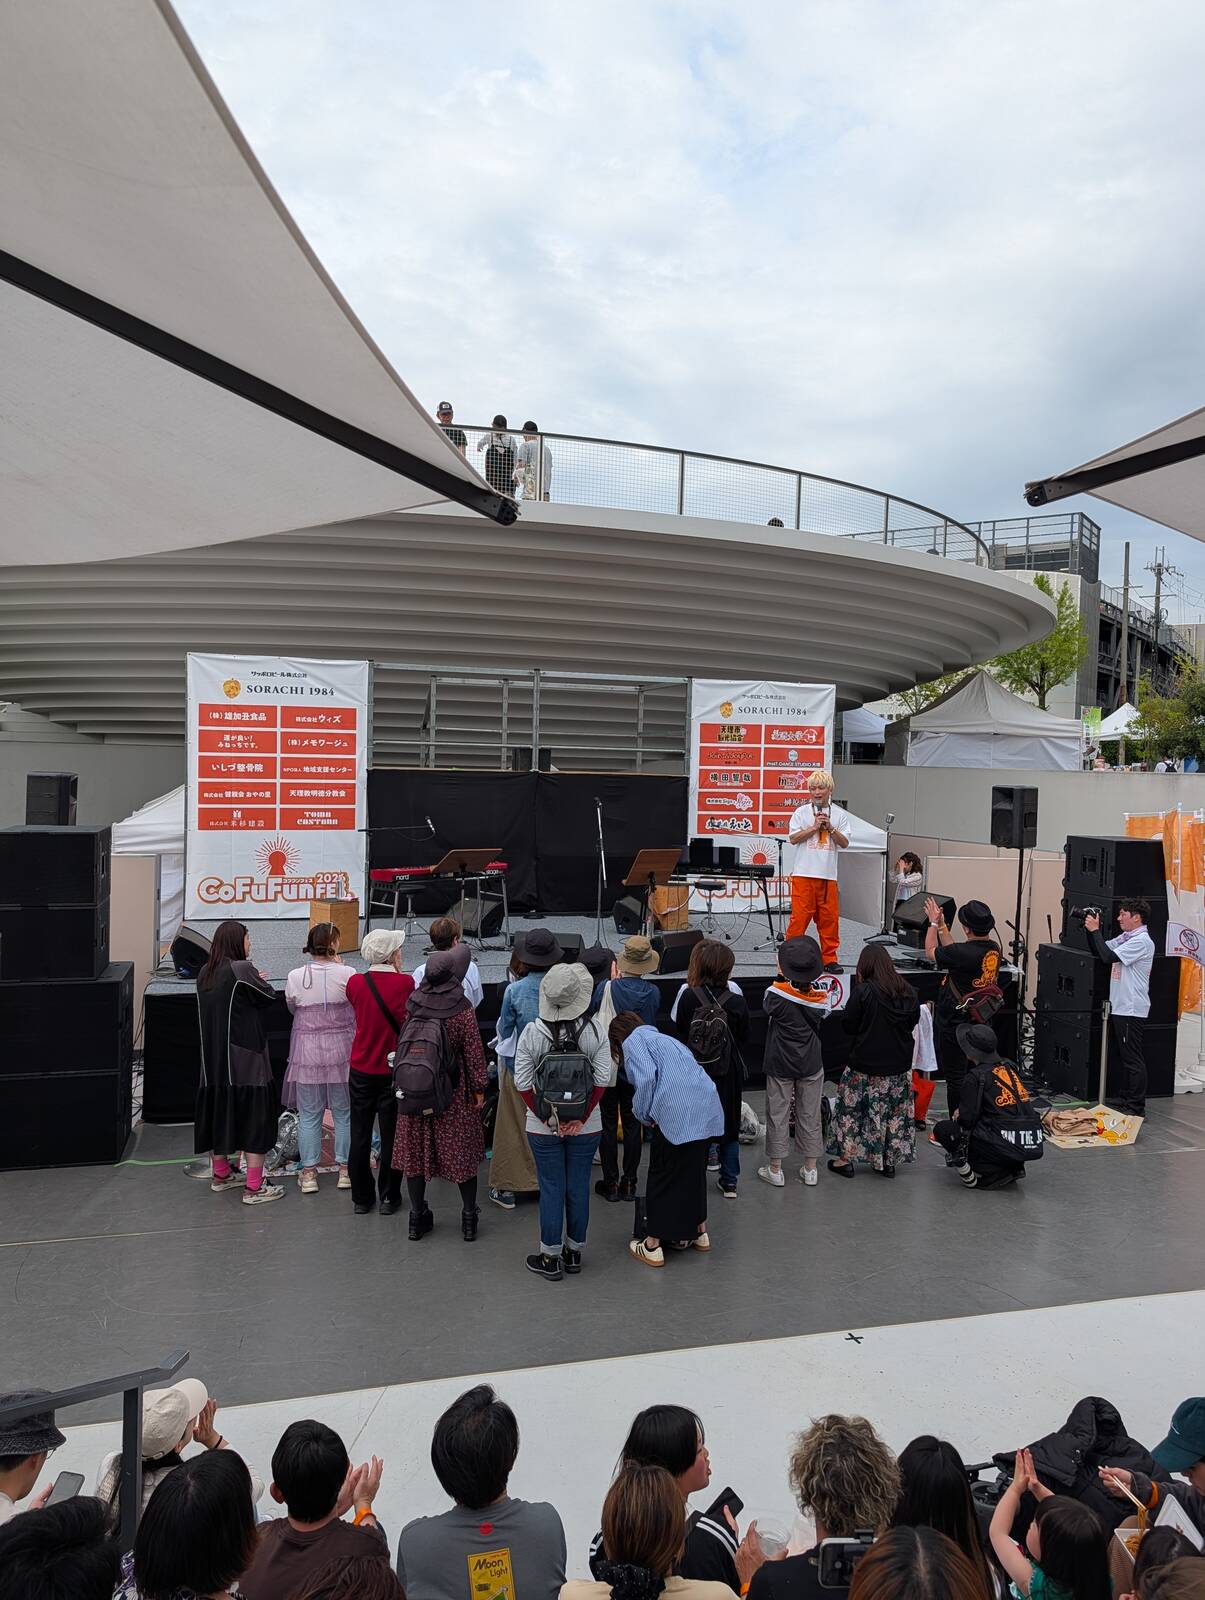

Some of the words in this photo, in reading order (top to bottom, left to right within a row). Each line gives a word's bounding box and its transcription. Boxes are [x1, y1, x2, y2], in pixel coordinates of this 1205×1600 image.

[246, 685, 304, 695] SORACHI
[309, 687, 335, 696] 1984
[738, 706, 783, 715] SORACHI
[786, 708, 807, 716] 1984
[318, 714, 342, 723] ウィズ
[211, 763, 264, 773] いしづ整骨院
[198, 877, 315, 902] CoFuFun
[1019, 1130, 1035, 1145] THE
[473, 1558, 504, 1572] Moon
[489, 1567, 508, 1578] Light
